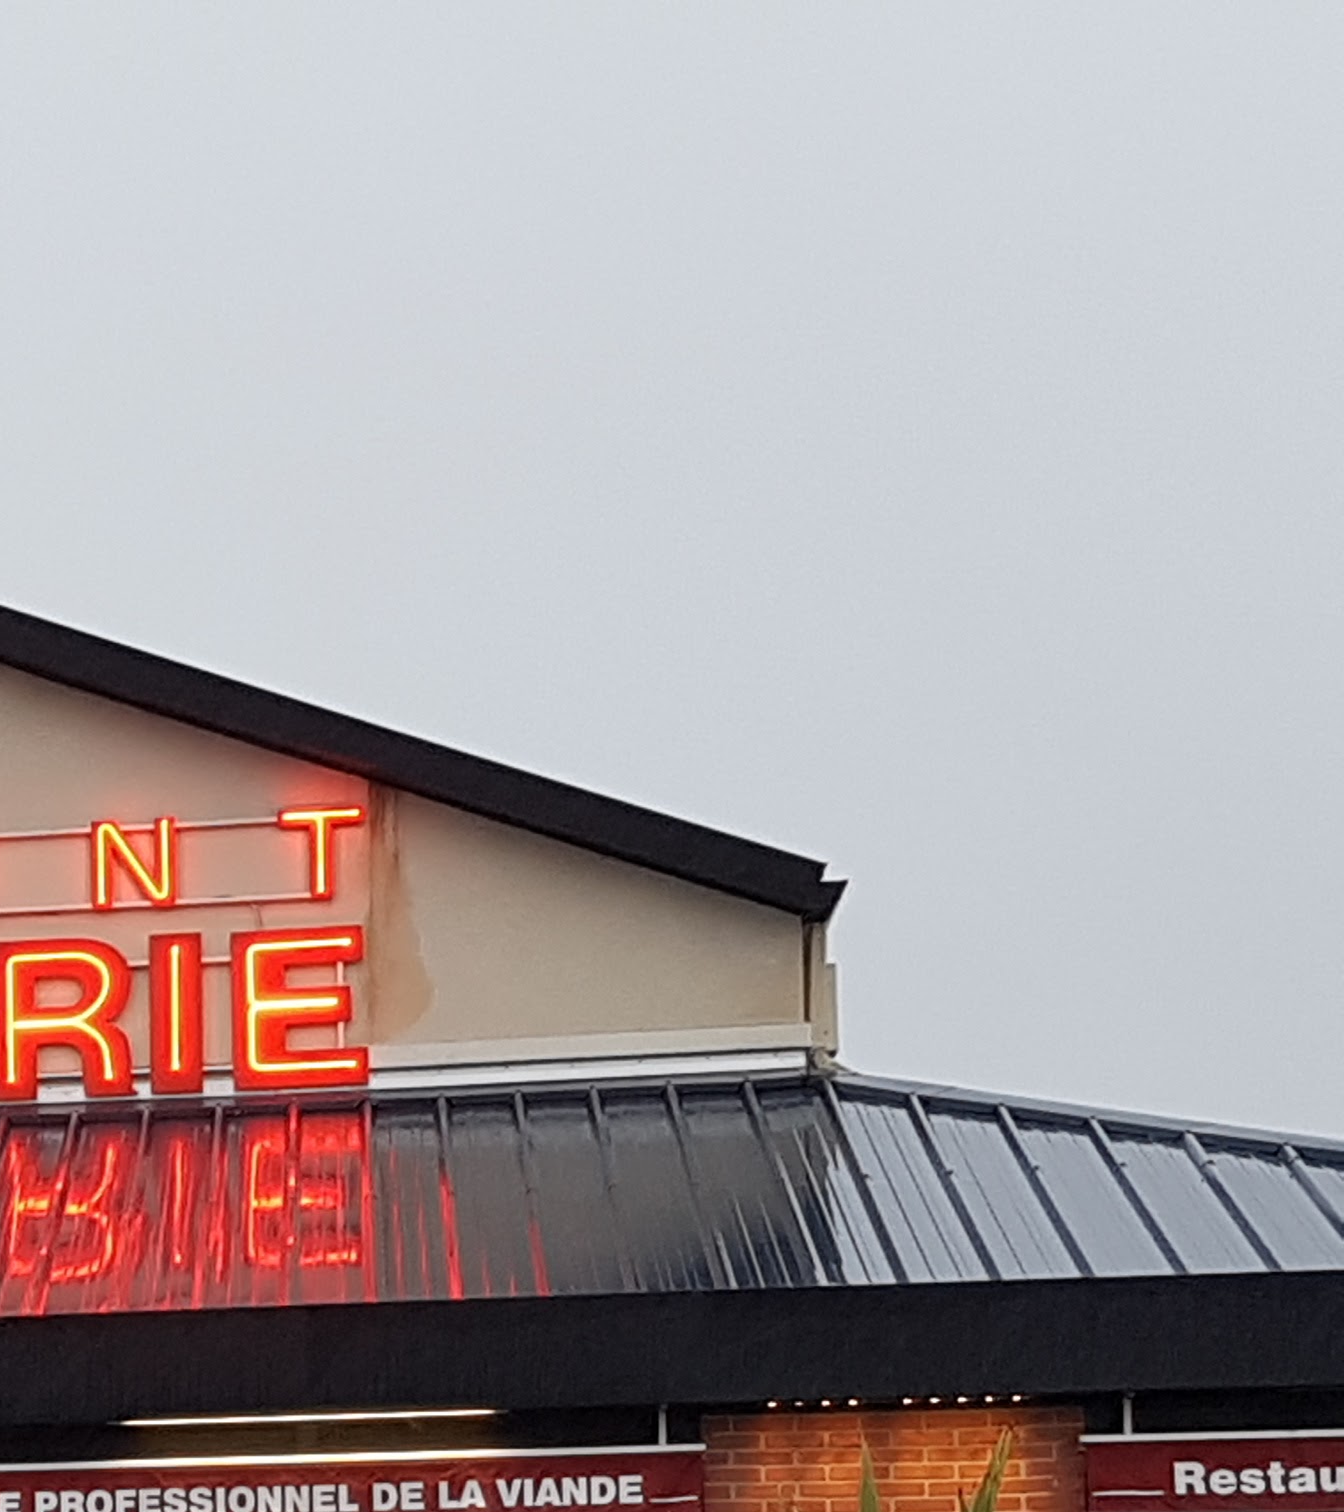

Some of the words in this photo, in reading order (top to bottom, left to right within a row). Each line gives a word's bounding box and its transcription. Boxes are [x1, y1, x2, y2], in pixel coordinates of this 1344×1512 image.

[372, 1481, 425, 1511] DE
[438, 1480, 486, 1509] LA
[496, 1475, 644, 1507] VIANDE
[1173, 1461, 1344, 1495] Restau
